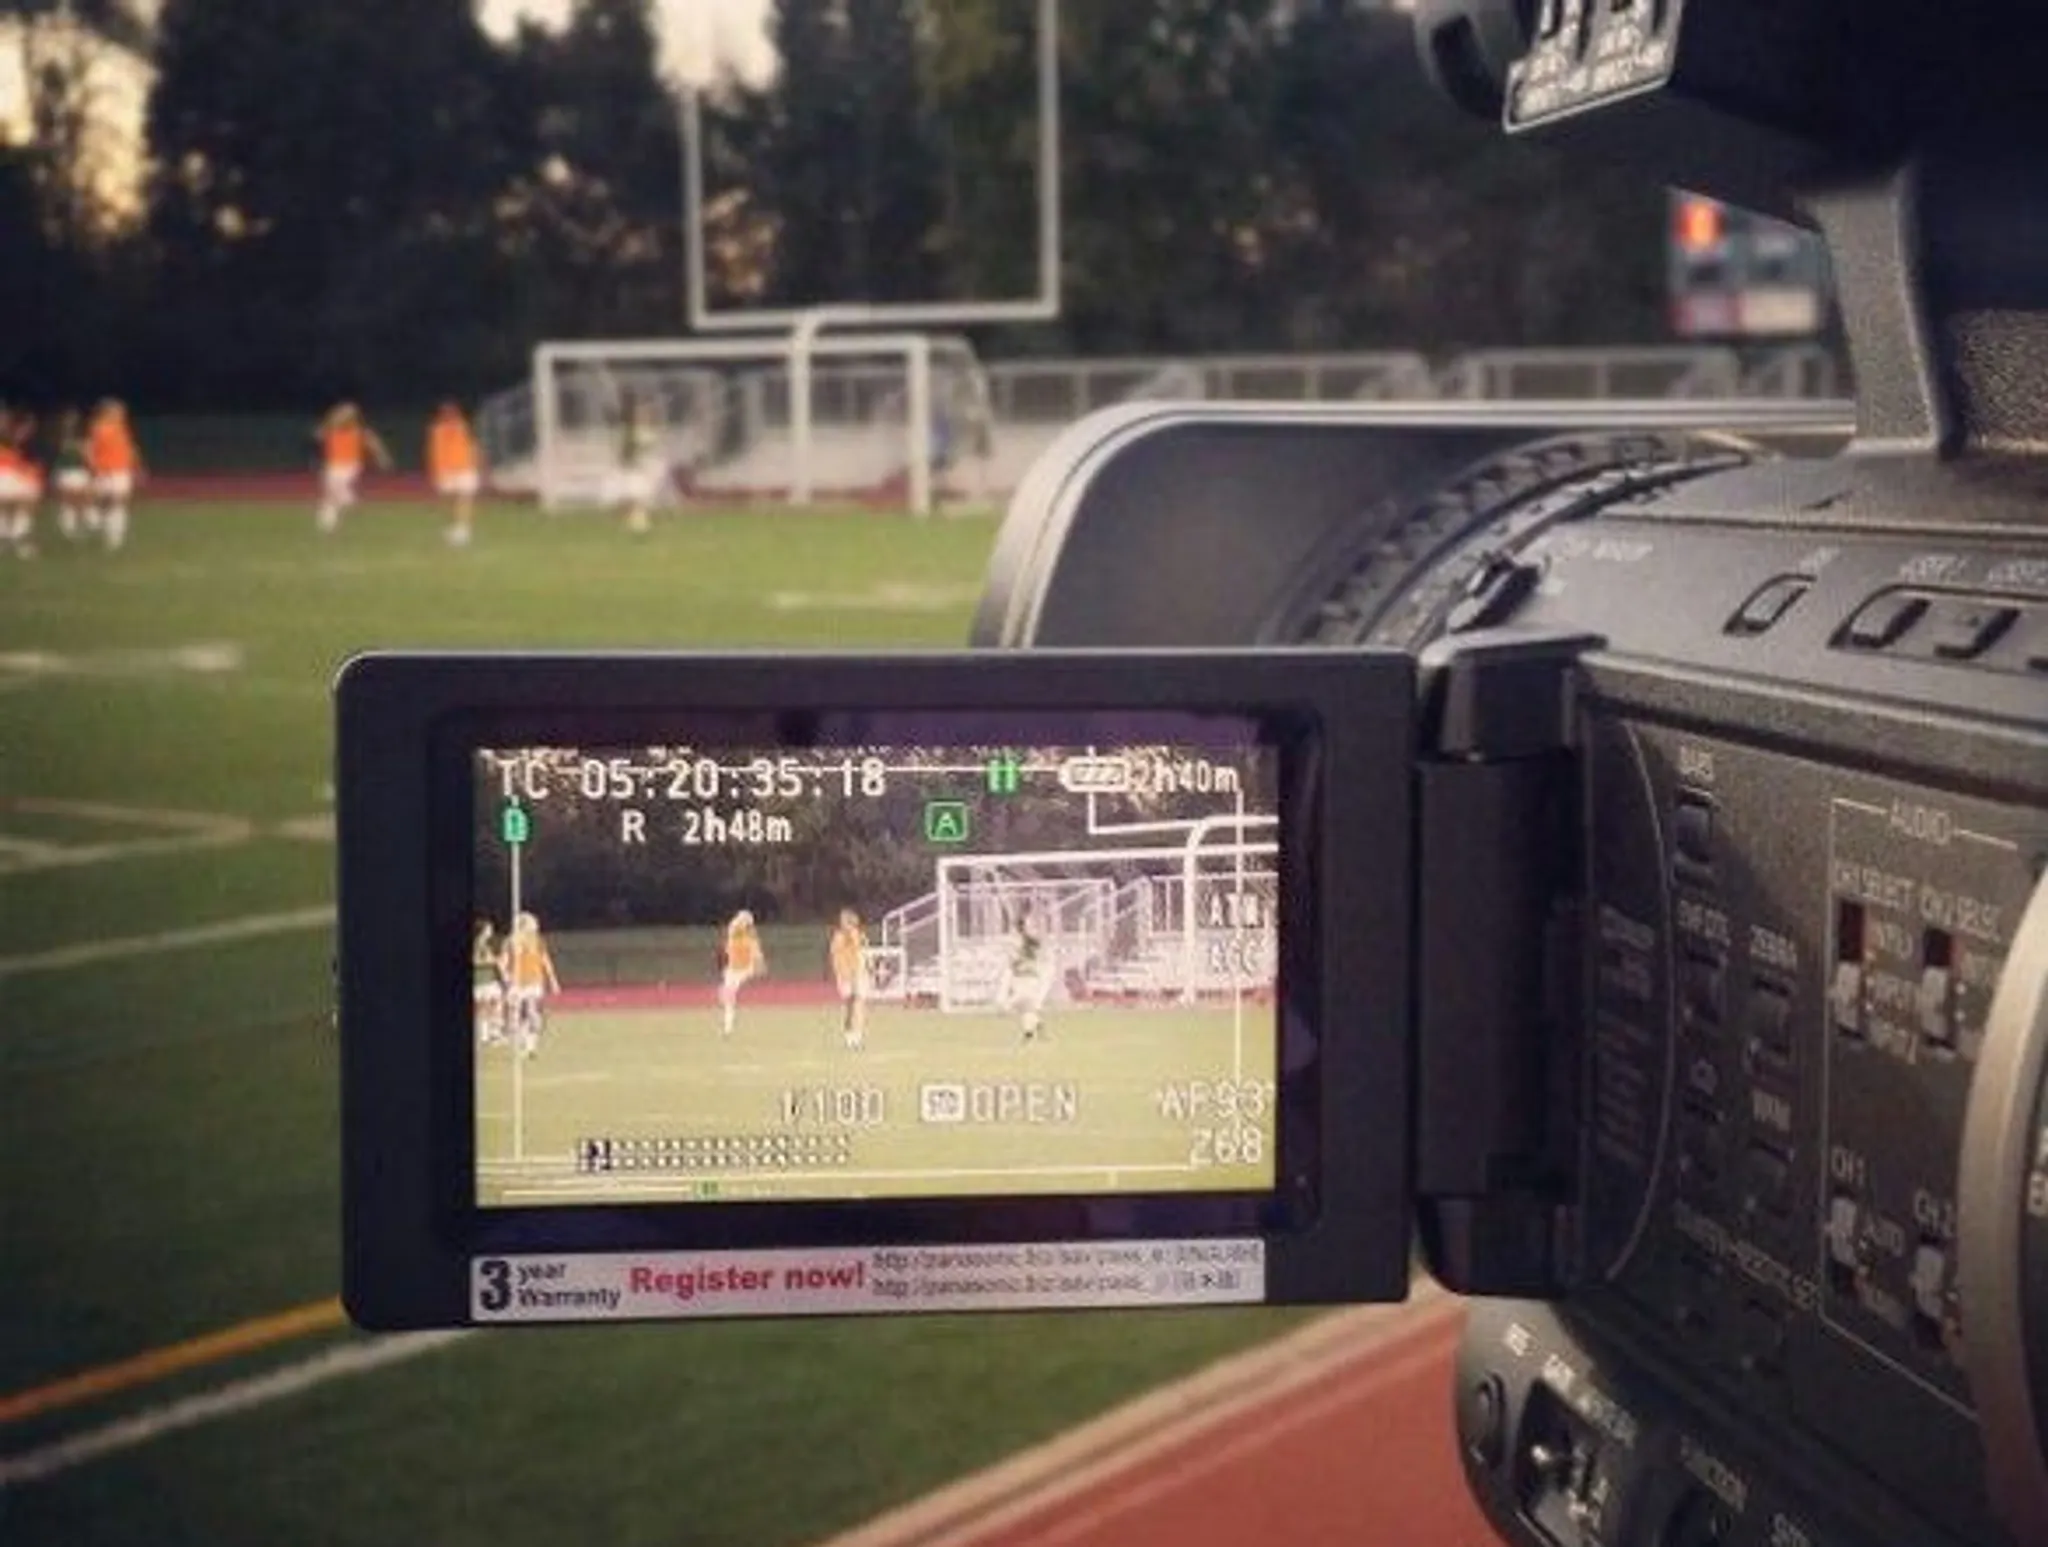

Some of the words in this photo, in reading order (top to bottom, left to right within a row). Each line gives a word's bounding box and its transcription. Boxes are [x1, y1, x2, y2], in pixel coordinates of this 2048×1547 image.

[499, 758, 550, 798] TC
[580, 758, 887, 798] 05:20:35:18
[621, 809, 646, 843] R
[682, 806, 792, 843] 2h48m
[972, 1084, 1077, 1123] OPEN
[480, 1260, 511, 1311] 3
[517, 1264, 566, 1286] year
[517, 1287, 621, 1310] Warranty
[630, 1265, 774, 1300] Register
[784, 1260, 865, 1291] now!
